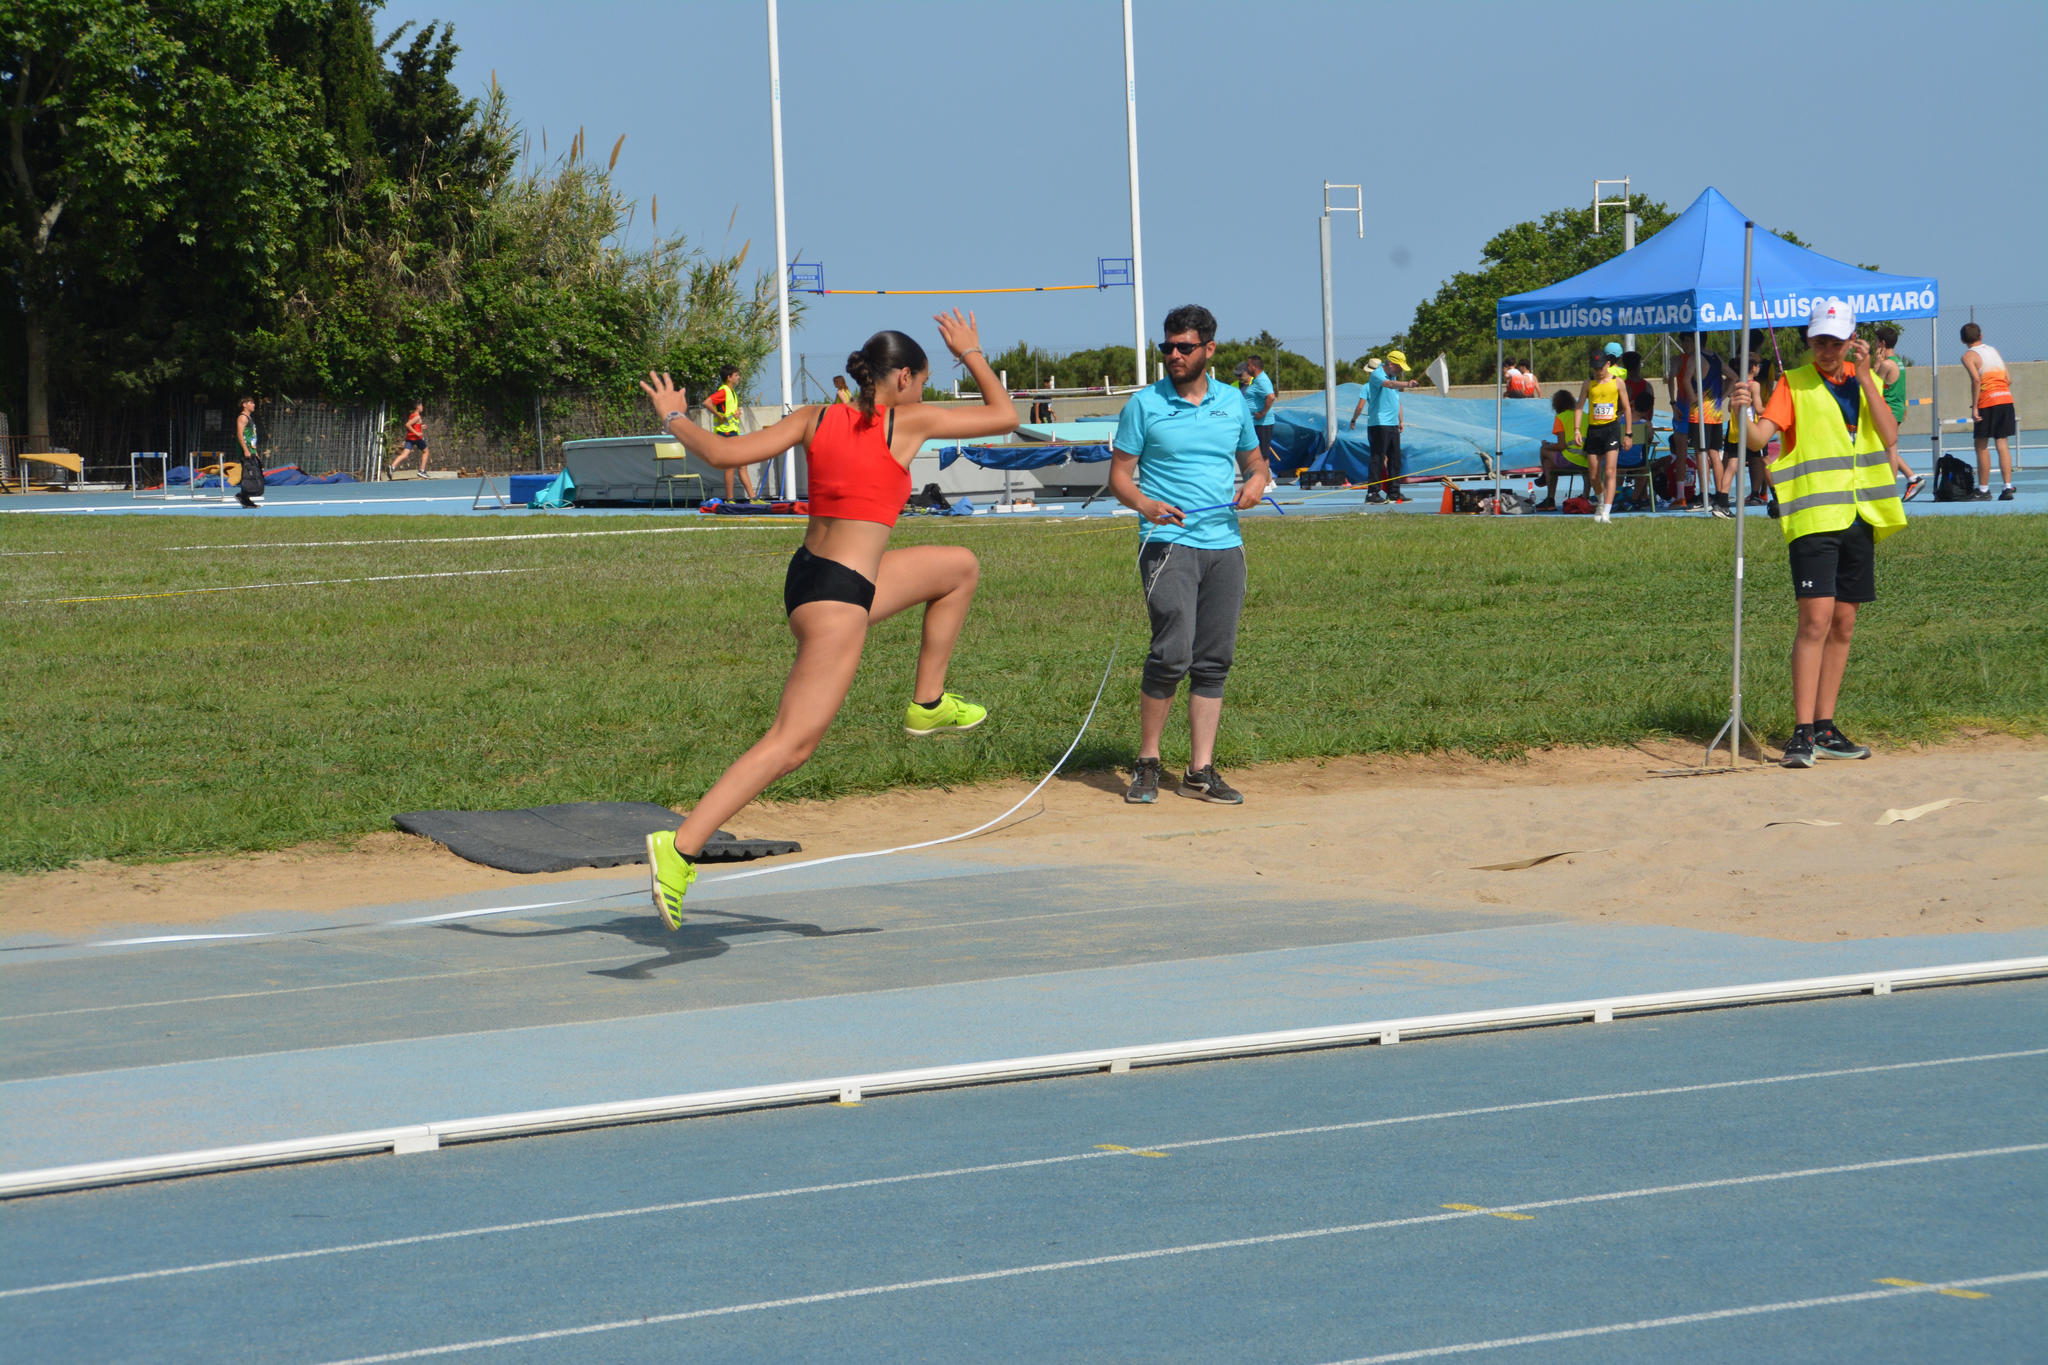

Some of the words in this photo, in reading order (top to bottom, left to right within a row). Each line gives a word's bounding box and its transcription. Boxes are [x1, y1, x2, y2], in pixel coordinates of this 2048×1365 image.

[1501, 313, 1534, 331] G.A.
[1540, 304, 1612, 329] LLUÏSOS
[1618, 299, 1691, 325] MATARÓ
[1701, 303, 1743, 322] G.A.
[1847, 284, 1935, 313] MATARÓ
